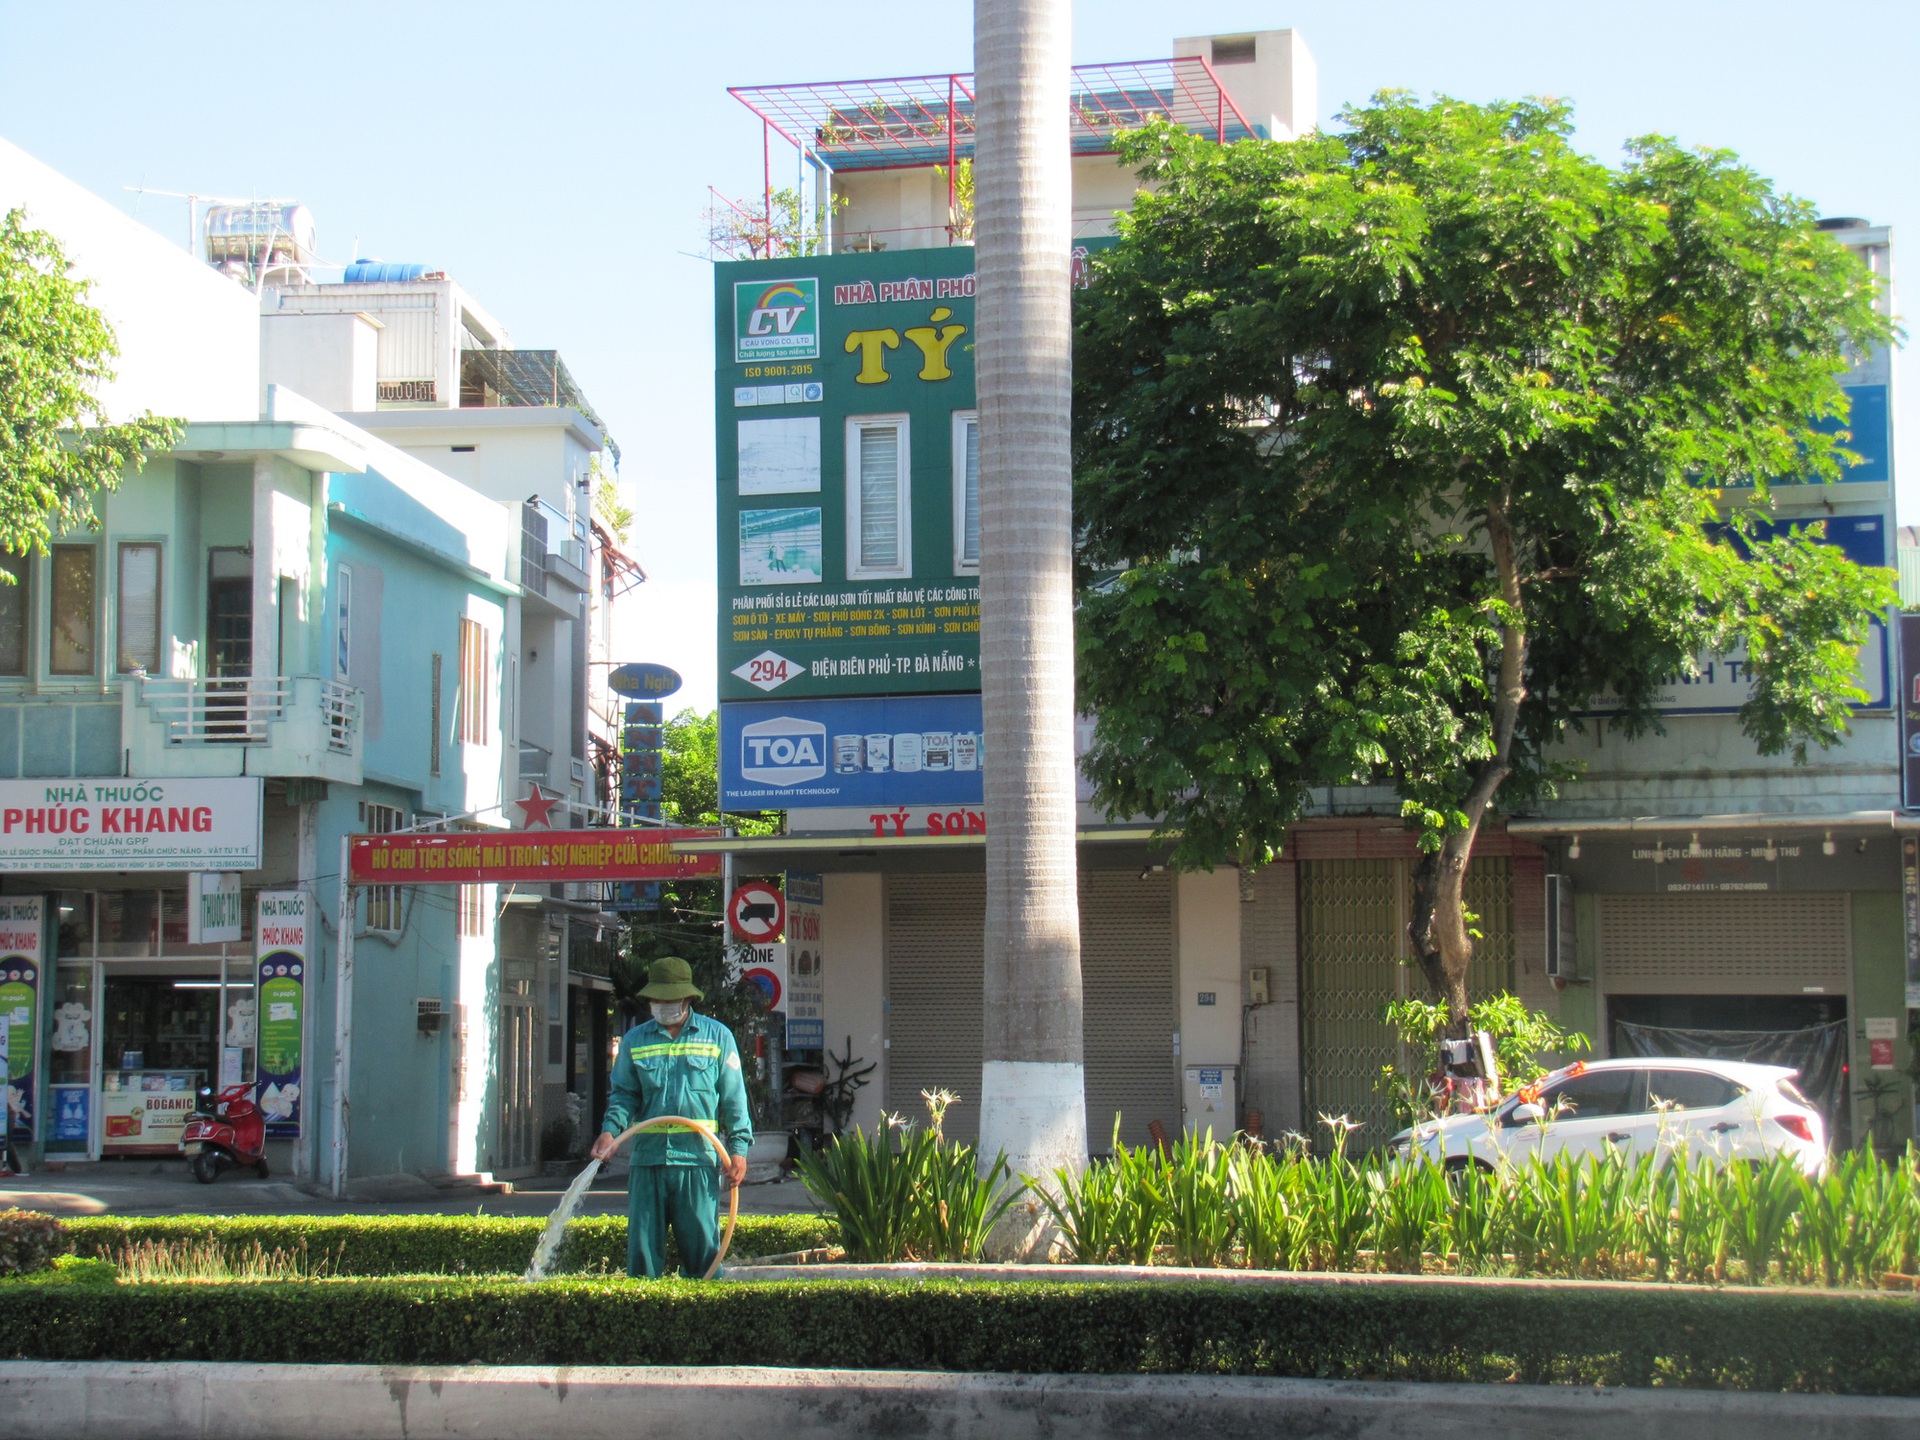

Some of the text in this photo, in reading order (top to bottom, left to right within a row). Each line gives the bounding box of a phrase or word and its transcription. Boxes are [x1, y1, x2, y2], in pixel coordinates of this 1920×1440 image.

[836, 272, 976, 305] NHÀ PHÂN PHỐ
[748, 307, 806, 335] CV
[844, 306, 968, 384] TÝ
[745, 367, 761, 377] ISO
[733, 596, 754, 610] PHÂN
[756, 594, 774, 608] PHỐI
[803, 593, 819, 607] CÁC
[820, 594, 838, 608] LOẠI
[840, 593, 856, 605] SƠN
[858, 589, 873, 604] TỐT
[874, 588, 895, 604] NHẤT
[897, 588, 913, 603] BẢO
[914, 588, 925, 604] VỆ
[927, 587, 943, 602] CÁC
[946, 587, 966, 601] CÔNG
[733, 614, 748, 625] SƠN
[758, 612, 768, 624] TÔ
[776, 614, 786, 624] XE
[788, 611, 806, 623] MÁY
[814, 612, 830, 622] SƠN
[832, 608, 848, 621] PHỦ
[850, 608, 872, 620] BÓNG
[874, 610, 884, 619] 2K
[892, 608, 908, 619] SƠN
[911, 606, 926, 618] LÓT
[934, 607, 951, 617] SƠN
[953, 603, 969, 616] PHỦ
[733, 631, 749, 641] SƠN
[751, 629, 767, 640] SÀN
[775, 629, 801, 639] EPOXY
[850, 626, 866, 636] SƠN
[898, 624, 914, 634] SƠN
[916, 621, 936, 633] KÍNH
[944, 621, 960, 632] SƠN
[963, 619, 980, 632] CHỐ
[750, 660, 787, 682] 294
[812, 658, 837, 679] ĐIỆN
[840, 656, 865, 675] BIÊN
[915, 654, 930, 673] ĐÀ
[932, 650, 963, 672] NẴNG
[748, 737, 819, 765] TOA
[926, 736, 949, 746] TOA
[46, 780, 164, 802] NHÀ THUỐC
[3, 803, 212, 834] PHÚC KHANG
[870, 806, 986, 838] TÝ SƠN
[59, 835, 149, 847] ĐẠT CHUẨN GPP
[372, 842, 390, 869] HỒ
[392, 841, 416, 869] CHỦ
[419, 848, 446, 872] TỊCH
[447, 840, 480, 868] SỐNG
[483, 842, 506, 867] MÃI
[510, 845, 550, 866] TRONG
[552, 843, 569, 870] SỰ
[570, 840, 613, 870] NGHIỆP
[615, 836, 638, 865] CỦA
[1633, 850, 1654, 859] LINH
[13, 899, 38, 920] THUỐC
[202, 880, 226, 928] THUỐC
[262, 894, 304, 916] NHÀ THUỐC
[15, 932, 36, 949] KHANG
[262, 923, 303, 945] PHÚC KHANG
[743, 948, 774, 963] ZONE
[1200, 994, 1214, 1002] 294
[147, 1098, 193, 1109] BOGANIC
